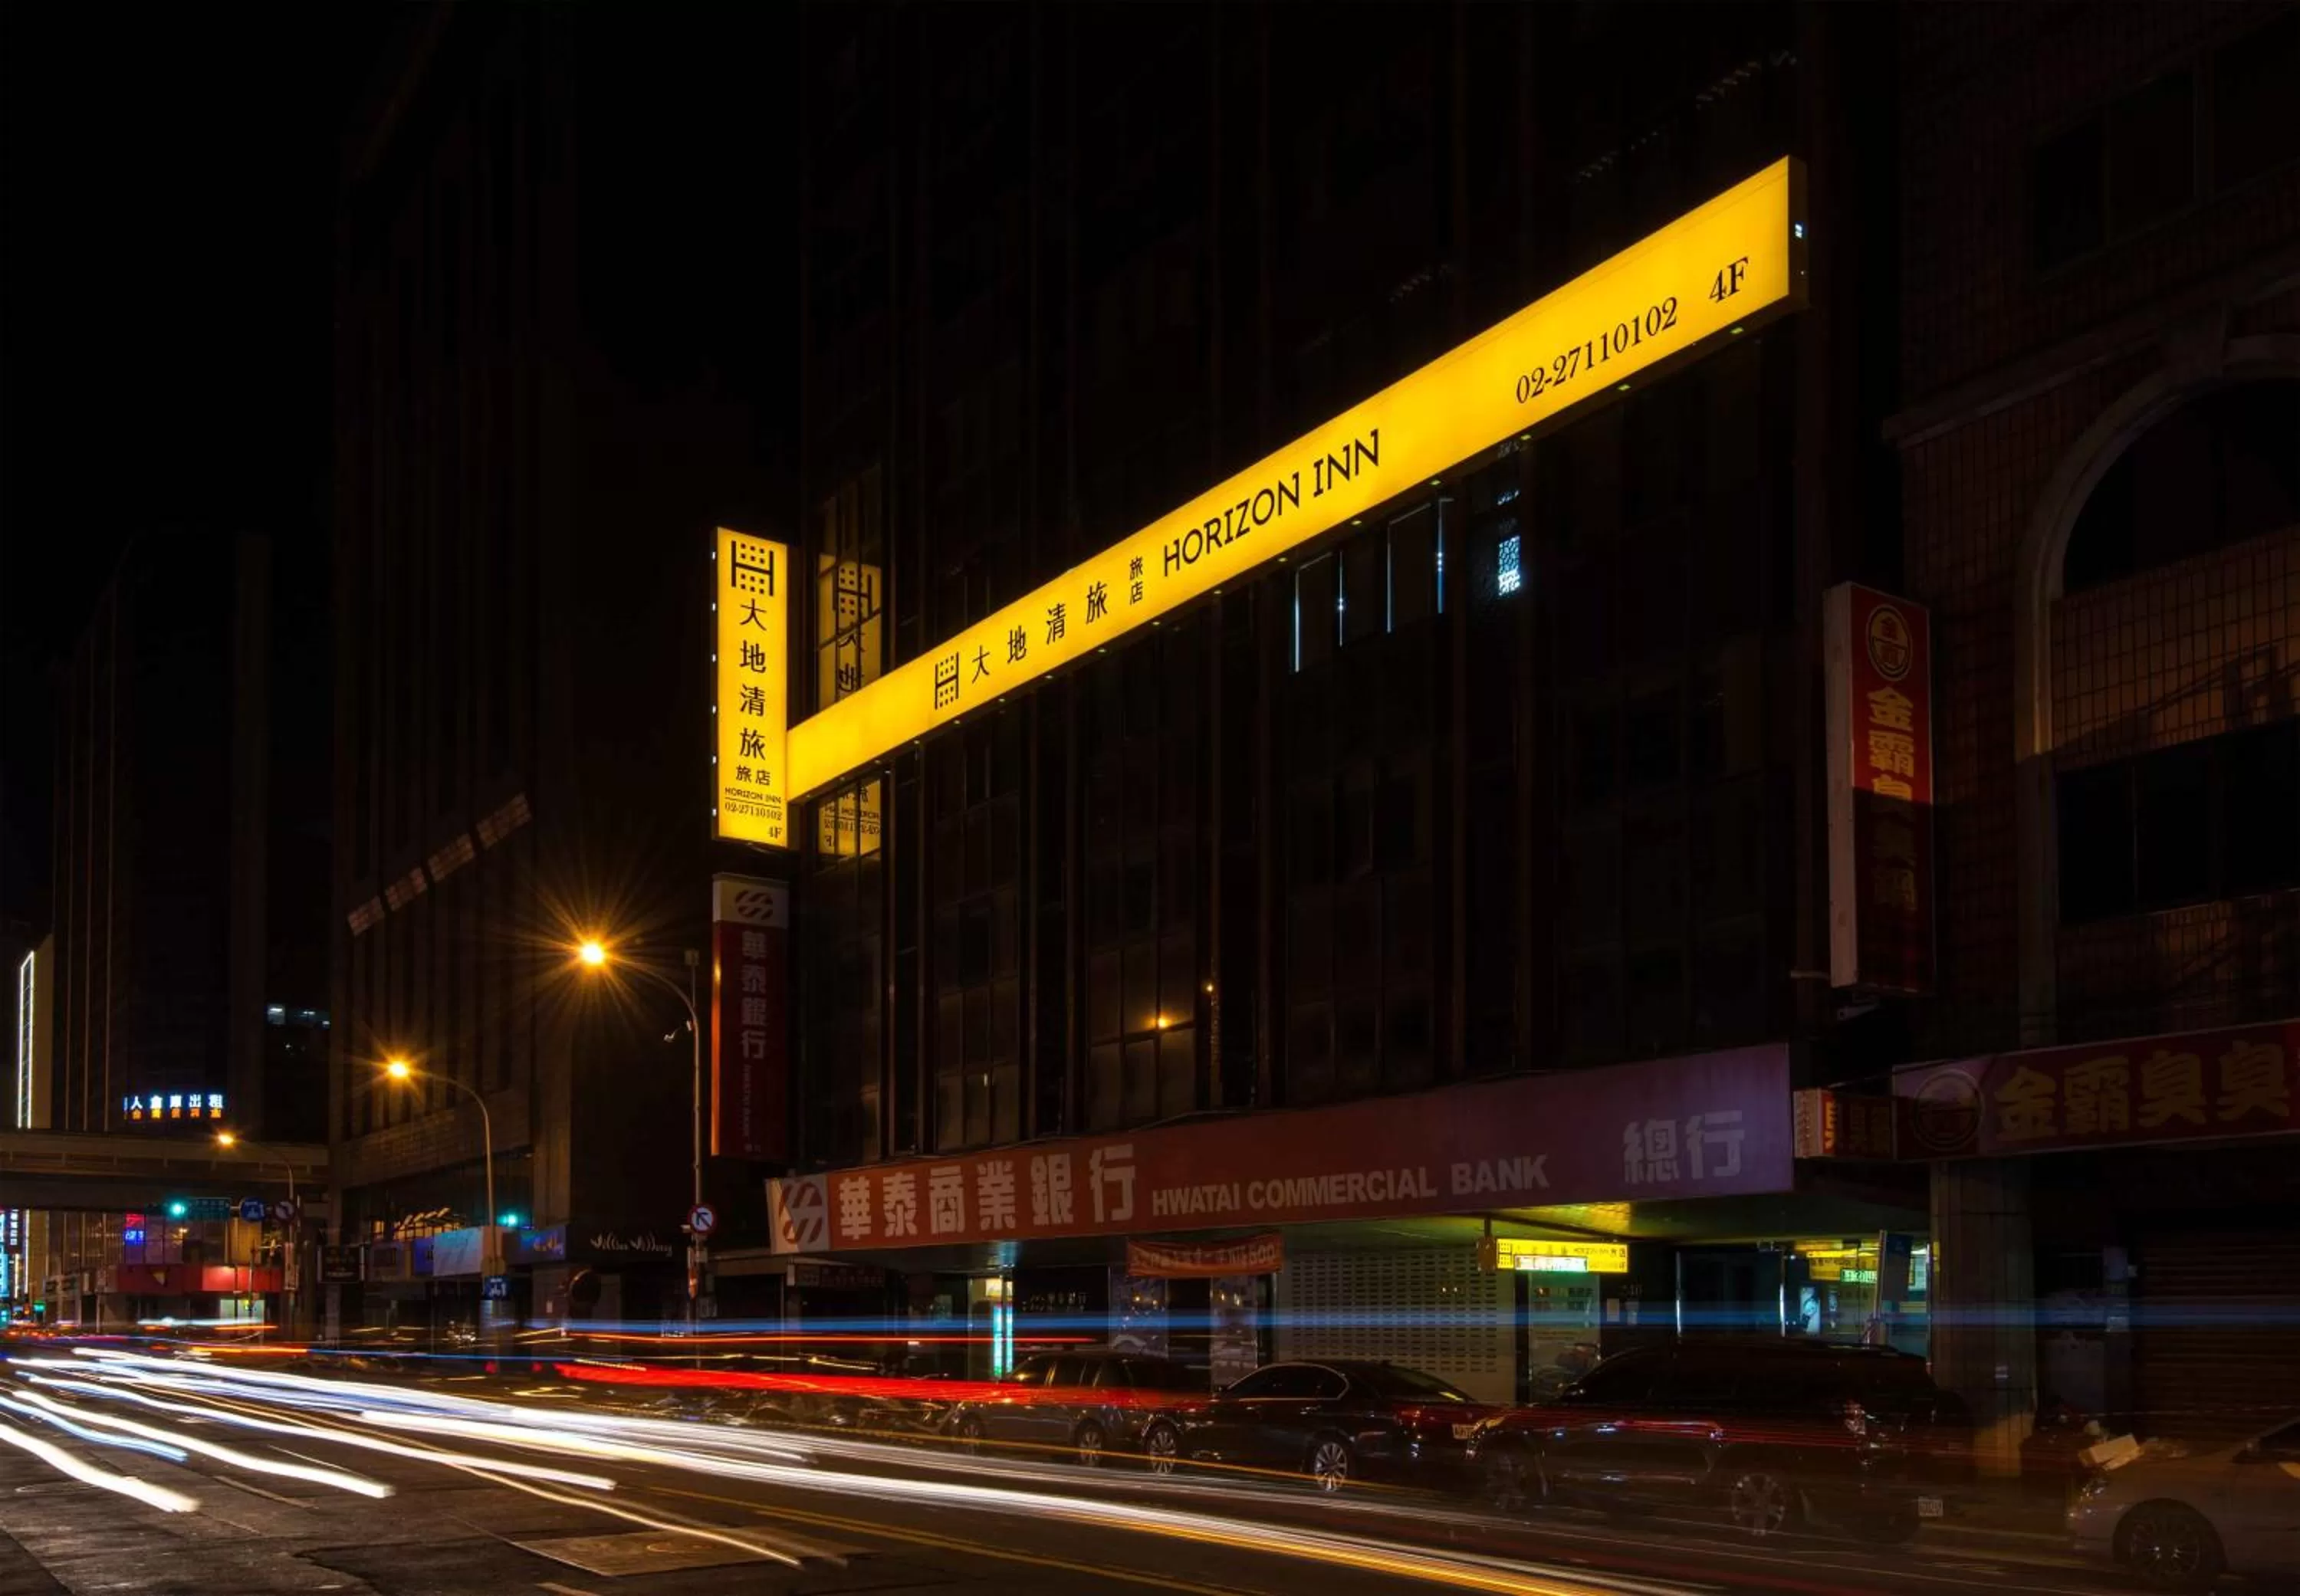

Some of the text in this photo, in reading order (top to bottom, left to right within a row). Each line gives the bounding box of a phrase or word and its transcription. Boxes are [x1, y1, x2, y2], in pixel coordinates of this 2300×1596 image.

[1516, 256, 1749, 404] 02-27110102 4F
[1162, 429, 1380, 577] HORIZON INN
[1129, 555, 1144, 606] 旅店
[971, 580, 1109, 685] 大地清旅
[739, 598, 767, 760] 大地清旅
[724, 787, 782, 804] HORIZON INN
[735, 764, 770, 787] 旅店
[768, 826, 783, 839] 4F
[1622, 1109, 1746, 1184] 總行
[838, 1143, 1137, 1241] 華泰商業銀行
[1152, 1154, 1550, 1217] HWATAI COMMERCIAL BANK
